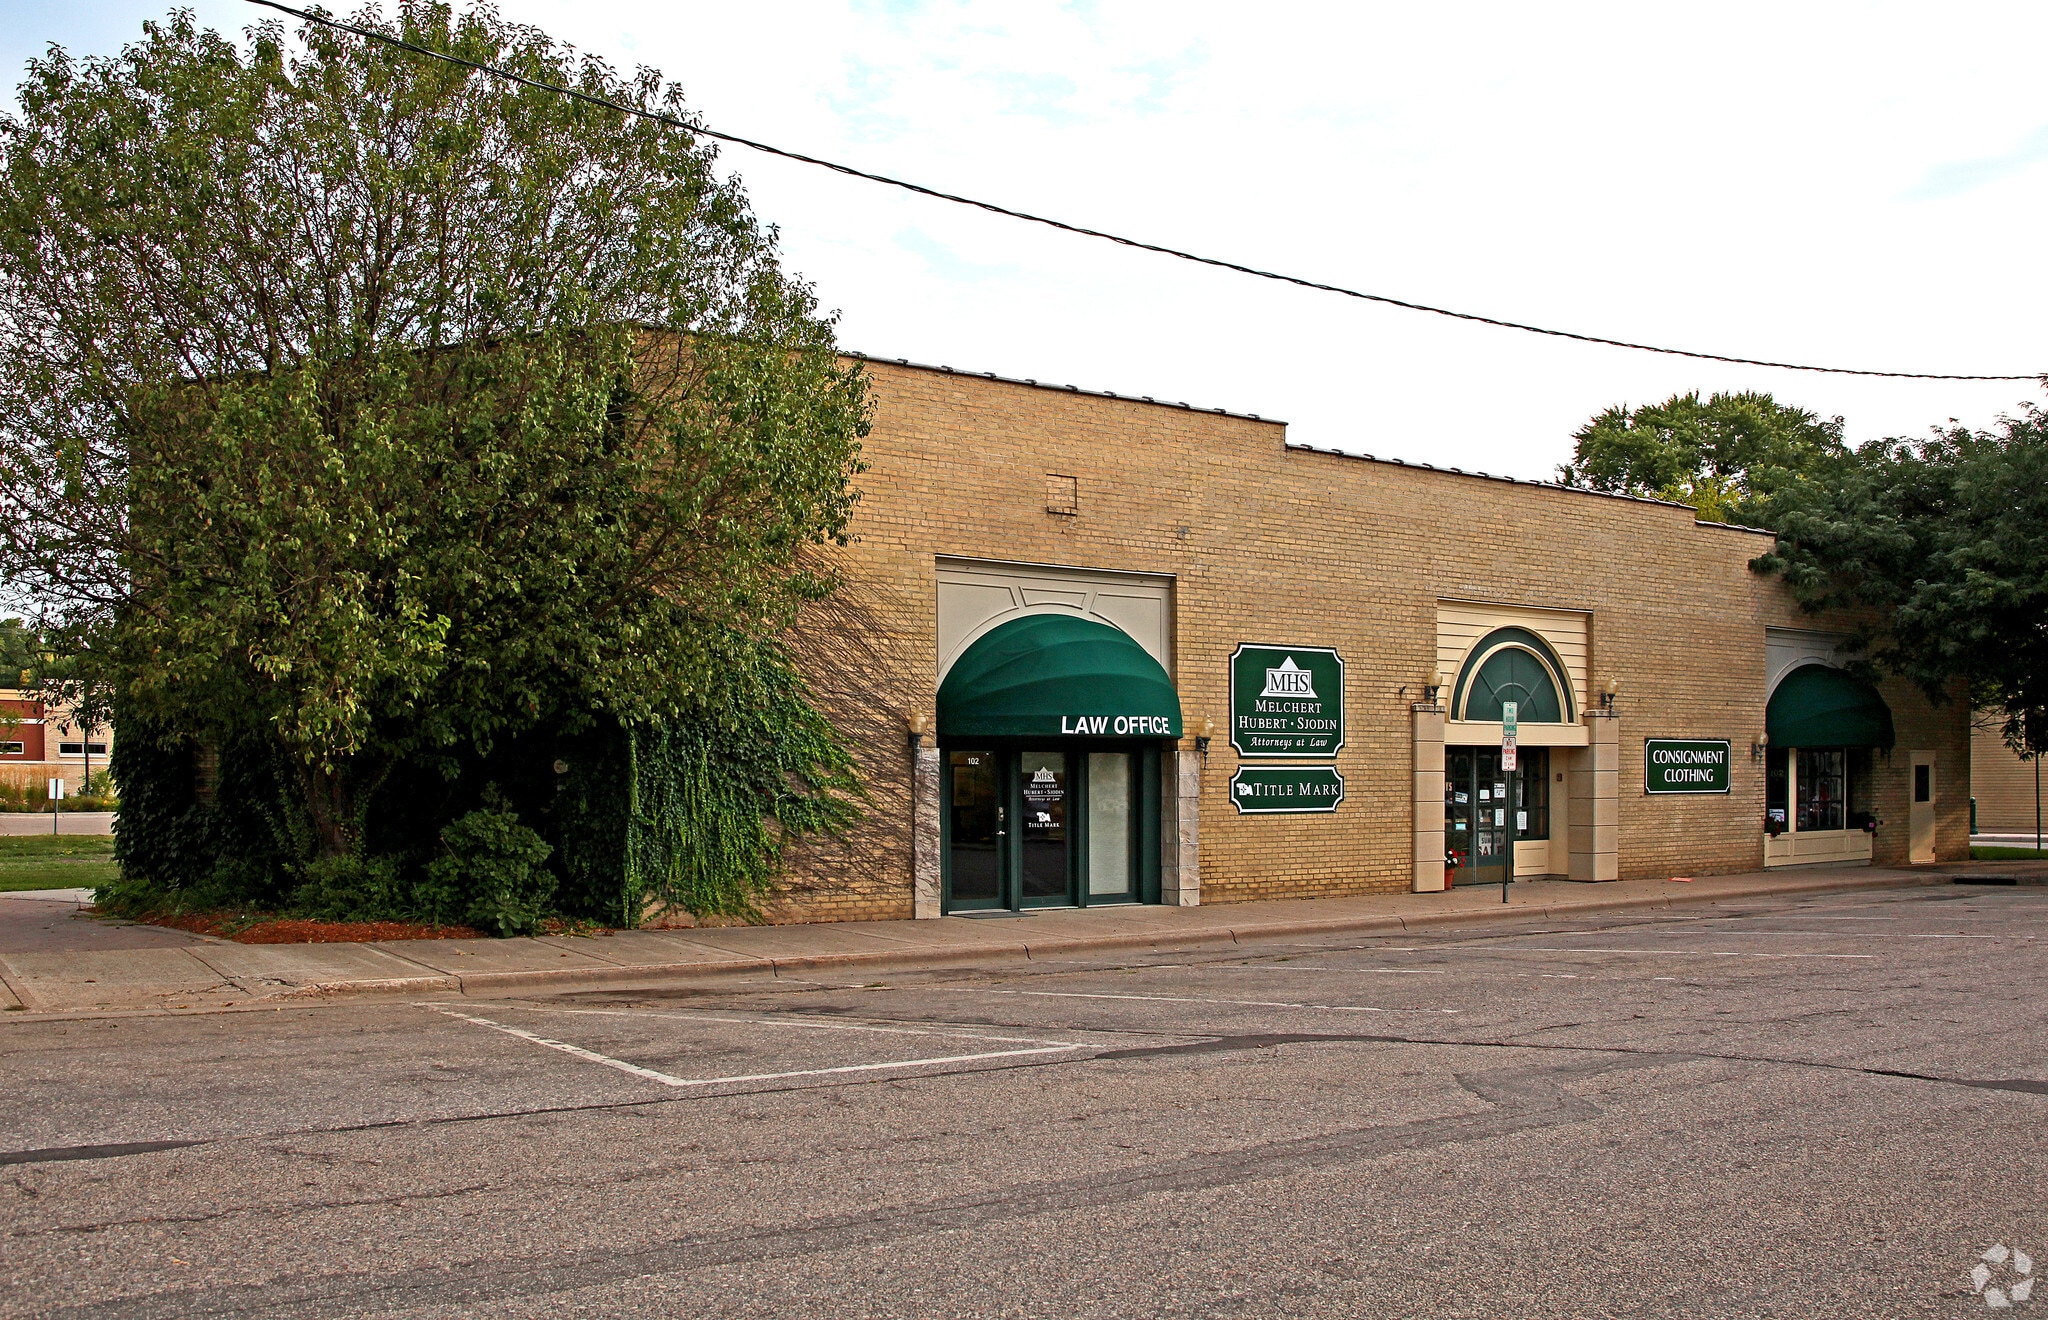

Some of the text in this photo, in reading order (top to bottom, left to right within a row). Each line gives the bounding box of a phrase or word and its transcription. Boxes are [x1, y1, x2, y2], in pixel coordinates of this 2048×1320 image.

[1270, 673, 1309, 692] MHS
[1255, 700, 1322, 714] MELCHERT
[1061, 716, 1171, 735] LAW OFFICE
[1239, 716, 1337, 730] HUBERT SJODIN
[1250, 736, 1328, 750] Attorneys at Law
[967, 757, 980, 765] 102
[1653, 750, 1724, 764] CONSIGNMENT
[1664, 769, 1714, 782] CLOTHING
[1254, 783, 1293, 796] TITLE
[1299, 783, 1339, 795] MARK
